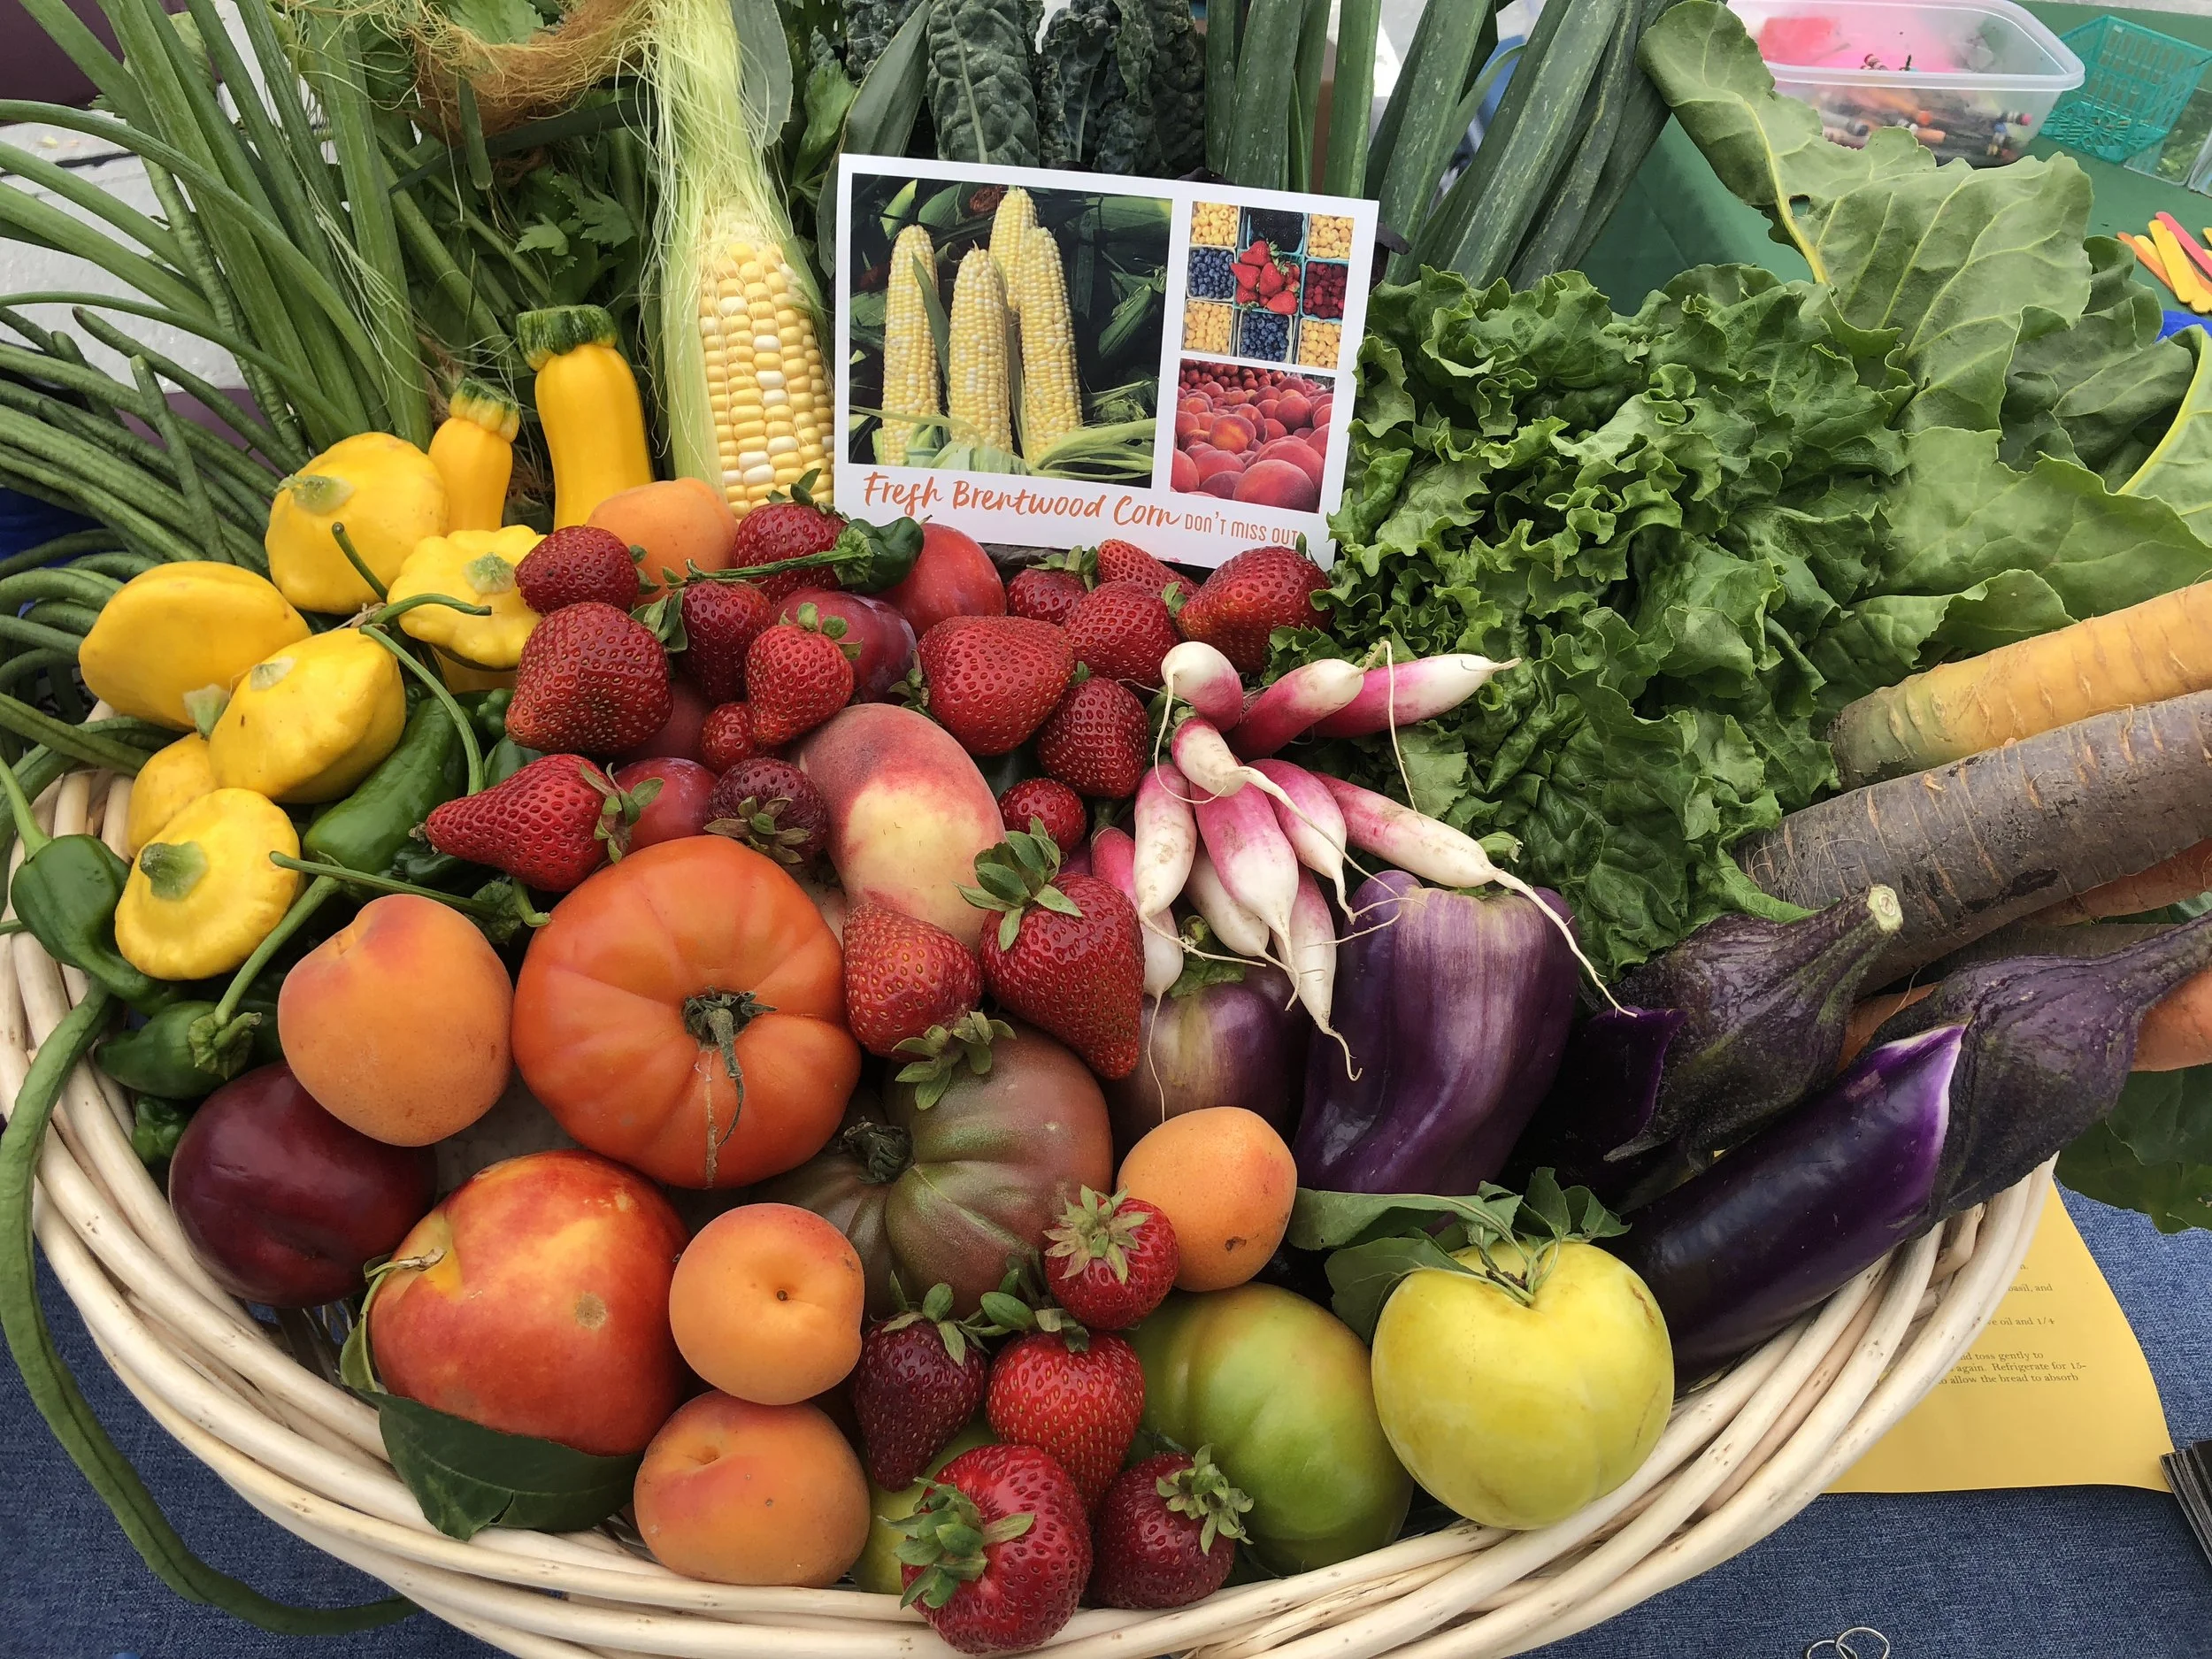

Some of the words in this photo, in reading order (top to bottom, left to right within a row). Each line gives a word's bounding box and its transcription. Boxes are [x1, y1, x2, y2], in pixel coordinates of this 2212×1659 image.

[863, 471, 944, 517] Fresh
[952, 480, 1107, 518] Brentwood
[1113, 495, 1182, 527] Corn
[1231, 520, 1267, 541] MISS
[2034, 1283, 2054, 1292] and
[2000, 1317, 2013, 1325] oil
[2015, 1317, 2034, 1325] and
[1961, 1352, 1972, 1361] nd
[1998, 1351, 2030, 1362] gently
[1956, 1363, 1987, 1374] again.
[1991, 1361, 2050, 1372] Refrigerate
[2051, 1362, 2067, 1371] for
[1950, 1375, 1977, 1385] allow
[1980, 1374, 1998, 1383] the
[2000, 1373, 2028, 1383] bread
[2044, 1372, 2079, 1382] absorb
